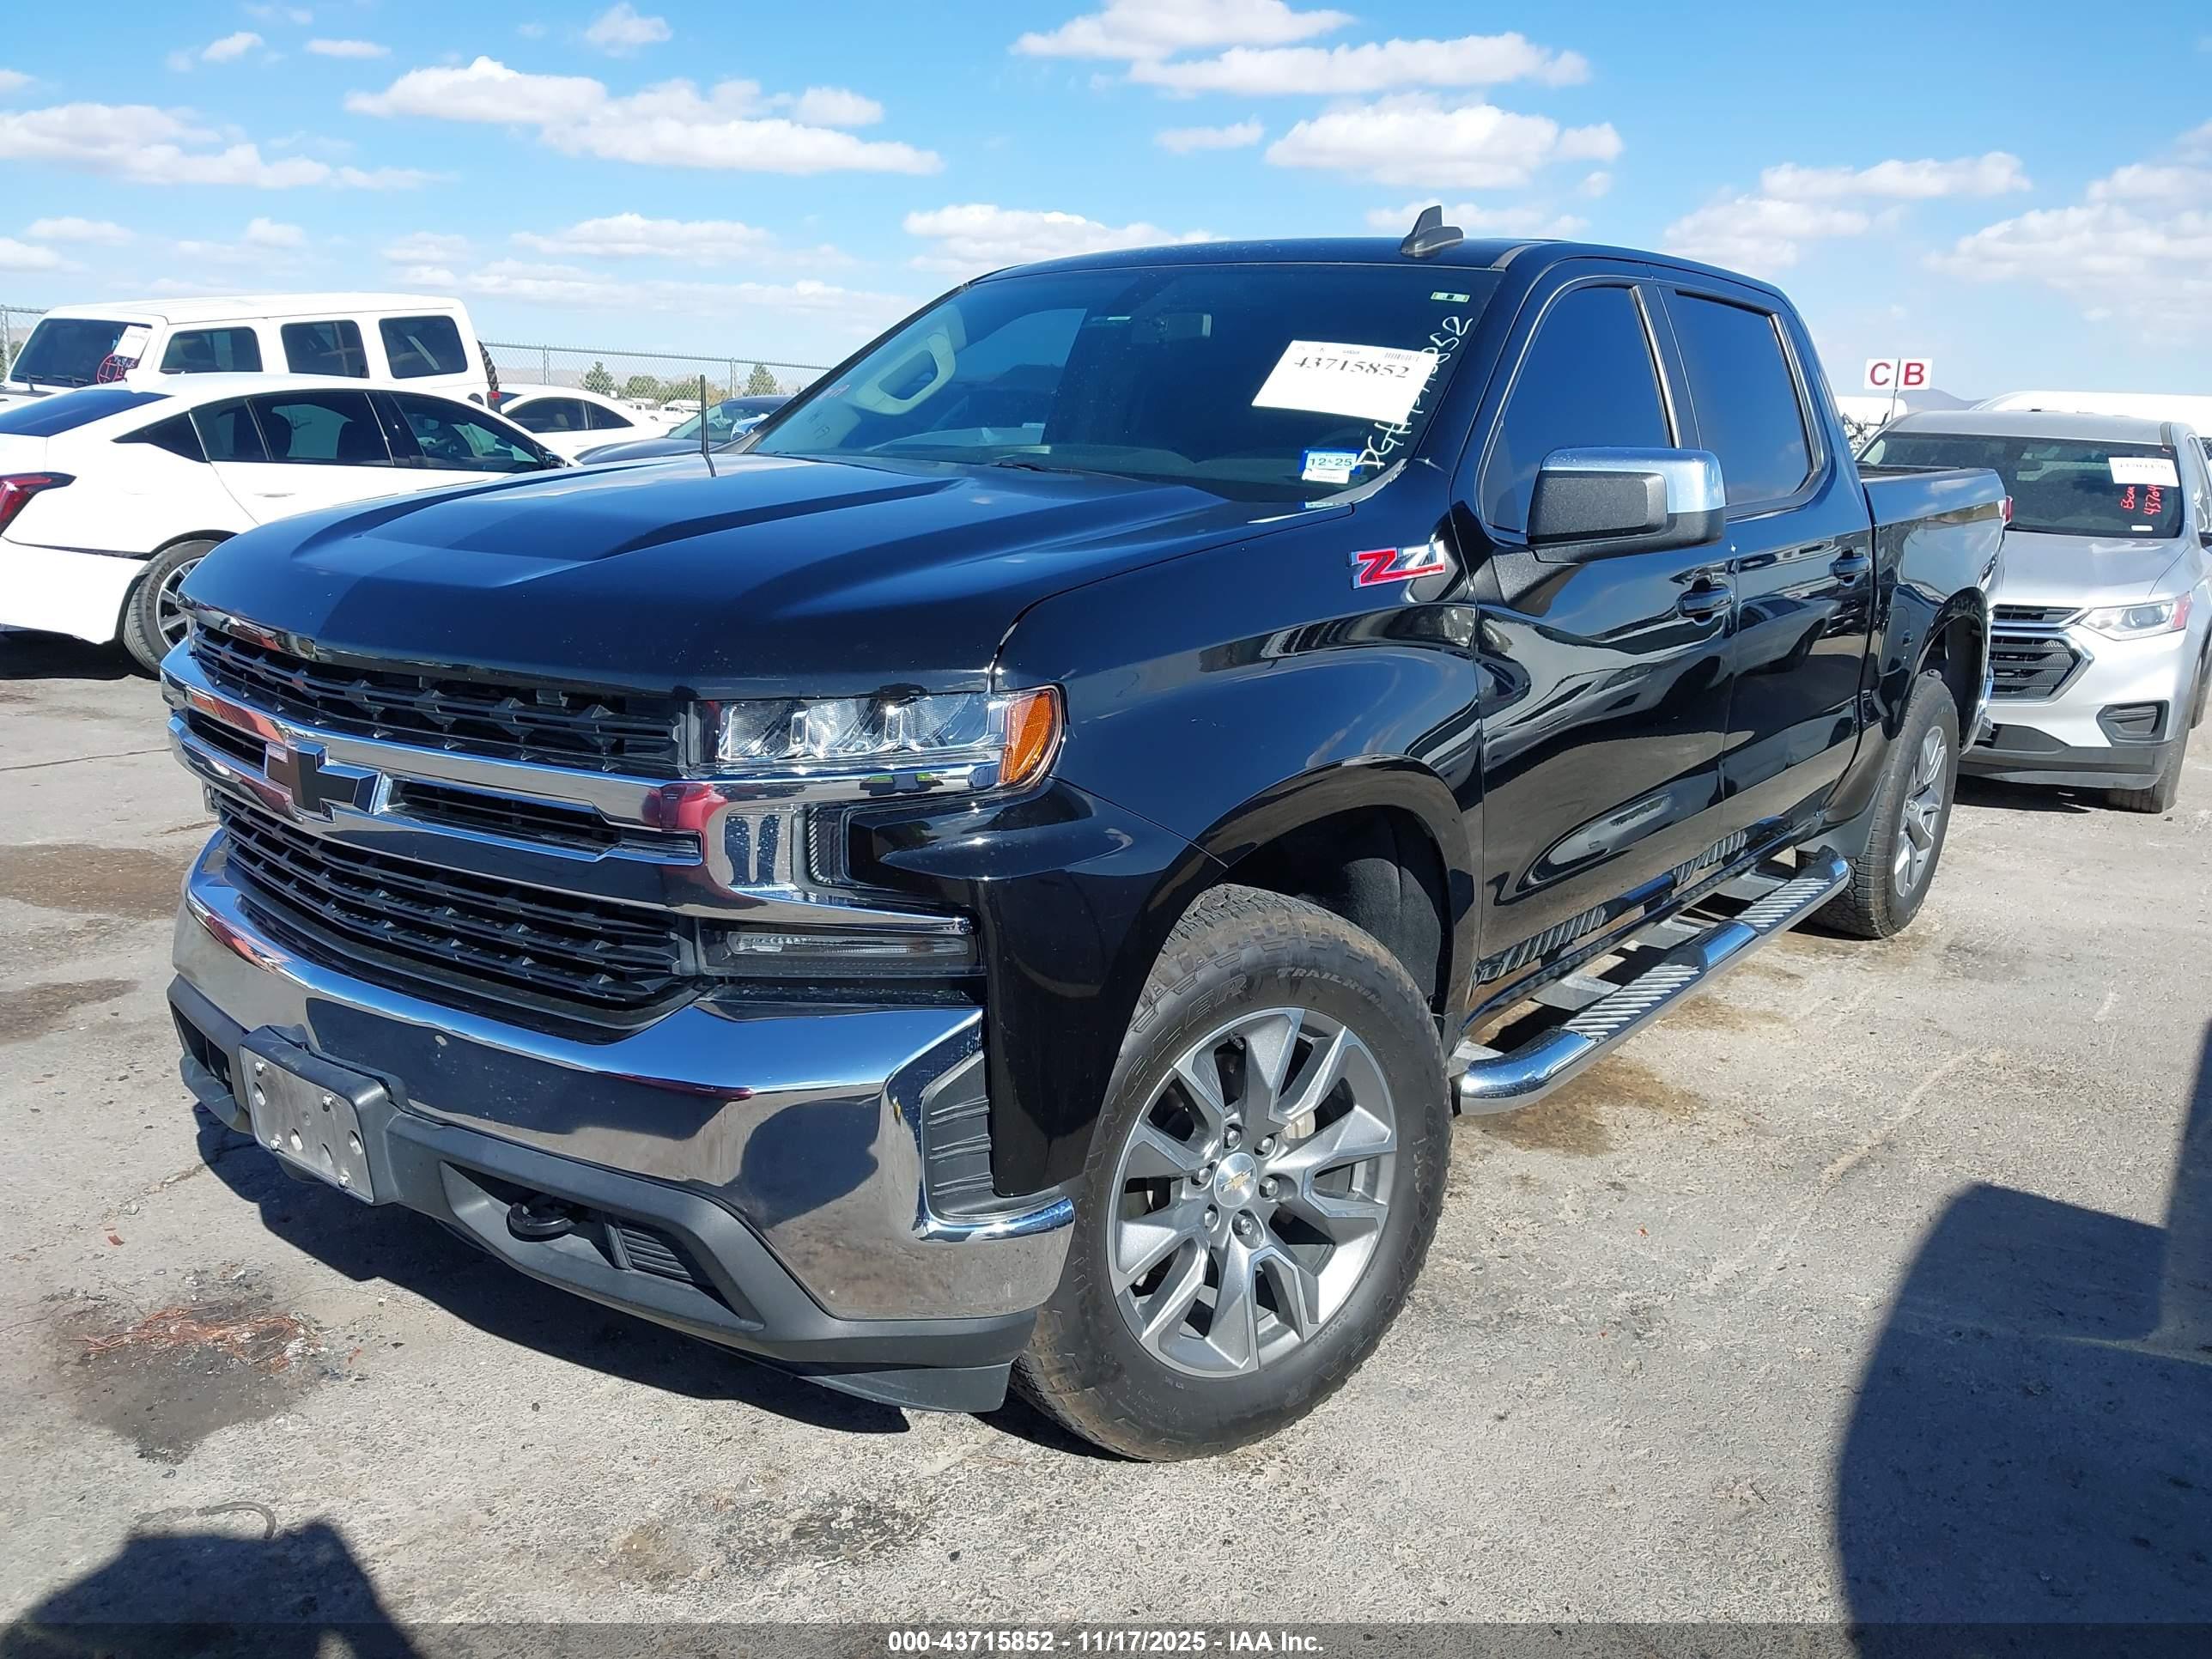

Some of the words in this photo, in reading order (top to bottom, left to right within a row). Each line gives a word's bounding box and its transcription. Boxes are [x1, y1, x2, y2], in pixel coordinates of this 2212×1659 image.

[1294, 356, 1409, 378] 43715852
[1869, 362, 1892, 386] C
[1904, 362, 1924, 386] B
[1349, 540, 1445, 590] Z71
